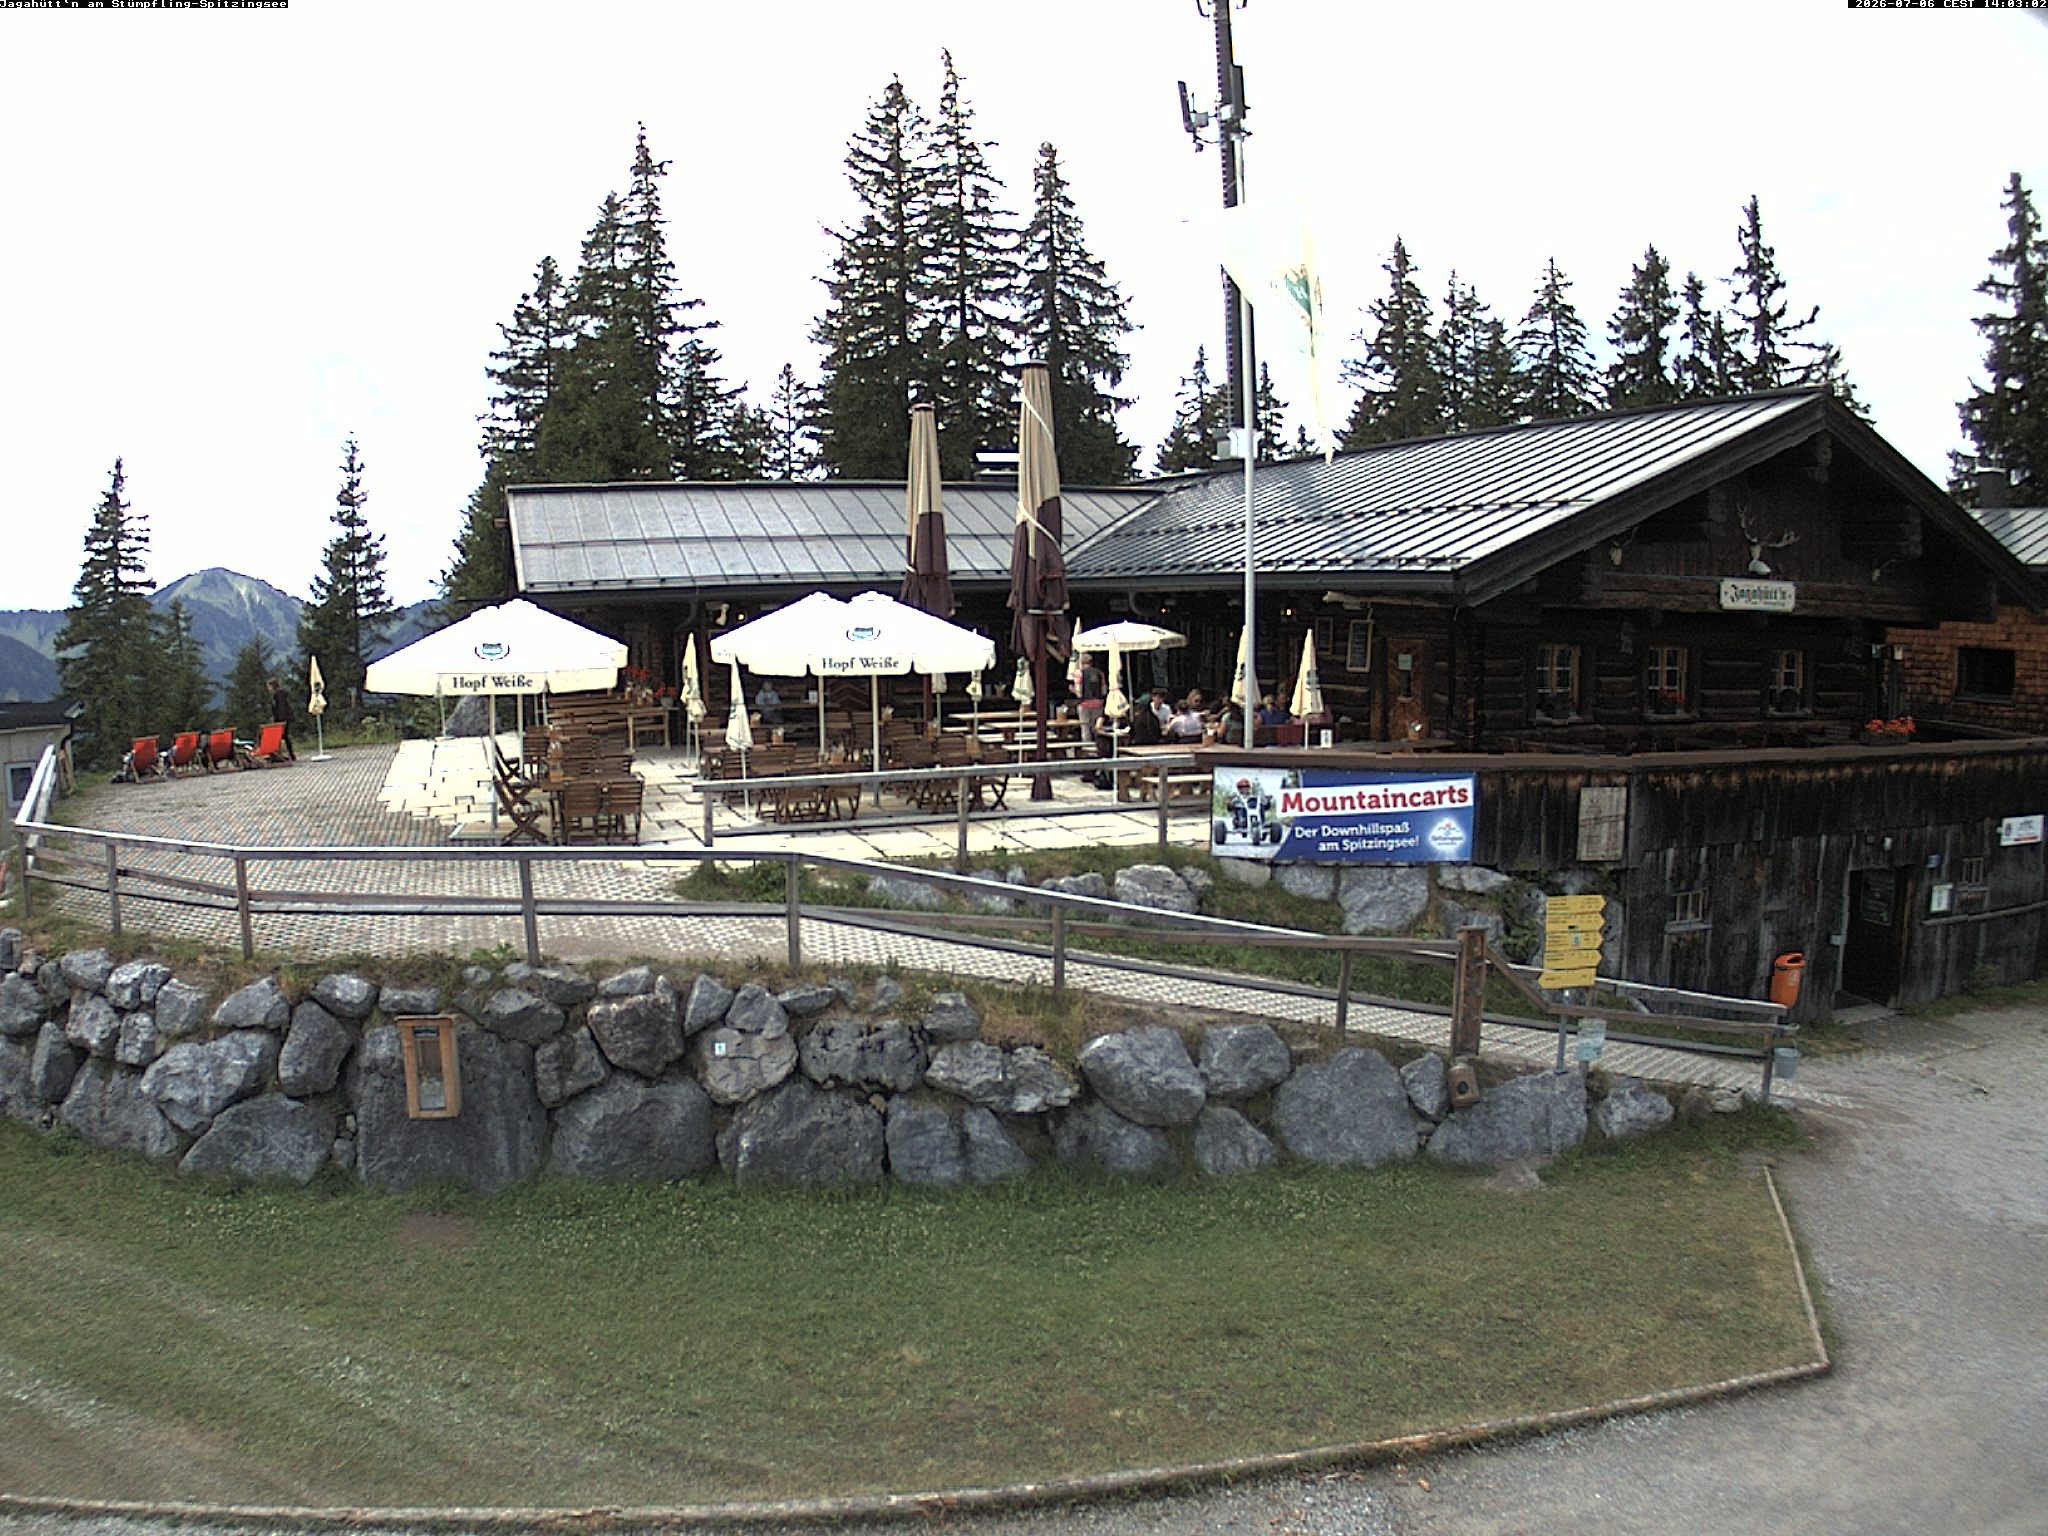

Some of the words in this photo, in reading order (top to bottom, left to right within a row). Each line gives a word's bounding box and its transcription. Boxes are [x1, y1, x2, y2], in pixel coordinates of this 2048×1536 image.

[822, 657, 855, 673] Hopf
[859, 656, 900, 669] Weiße
[452, 676, 486, 692] Hopf
[491, 675, 533, 689] Weiße
[1280, 785, 1469, 813] Mountaincarts
[1295, 826, 1318, 839] Der
[1321, 822, 1410, 838] Downhillspaß
[1318, 841, 1340, 852] am
[1342, 835, 1420, 853] Spitzingsee!
